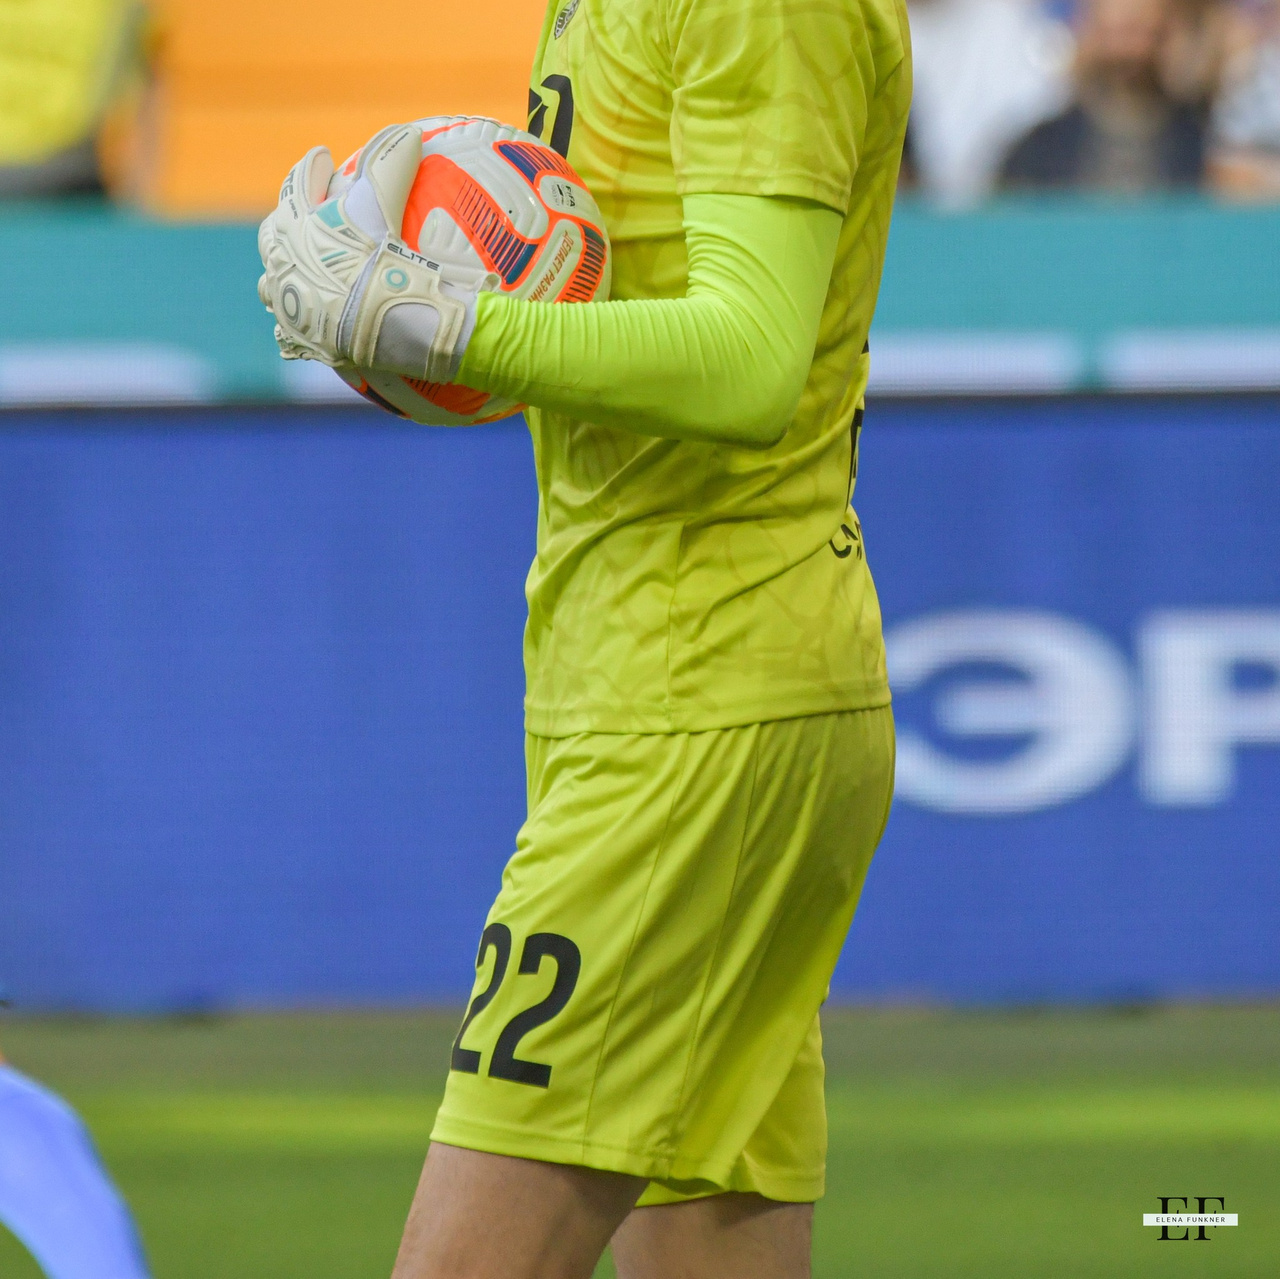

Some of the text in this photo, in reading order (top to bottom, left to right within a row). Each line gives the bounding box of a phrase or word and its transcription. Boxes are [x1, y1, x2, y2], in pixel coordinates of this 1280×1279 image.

[565, 185, 576, 207] FIFA
[387, 243, 440, 271] ELITE
[553, 230, 574, 275] ДЕЛАЕТ
[451, 922, 582, 1090] 22
